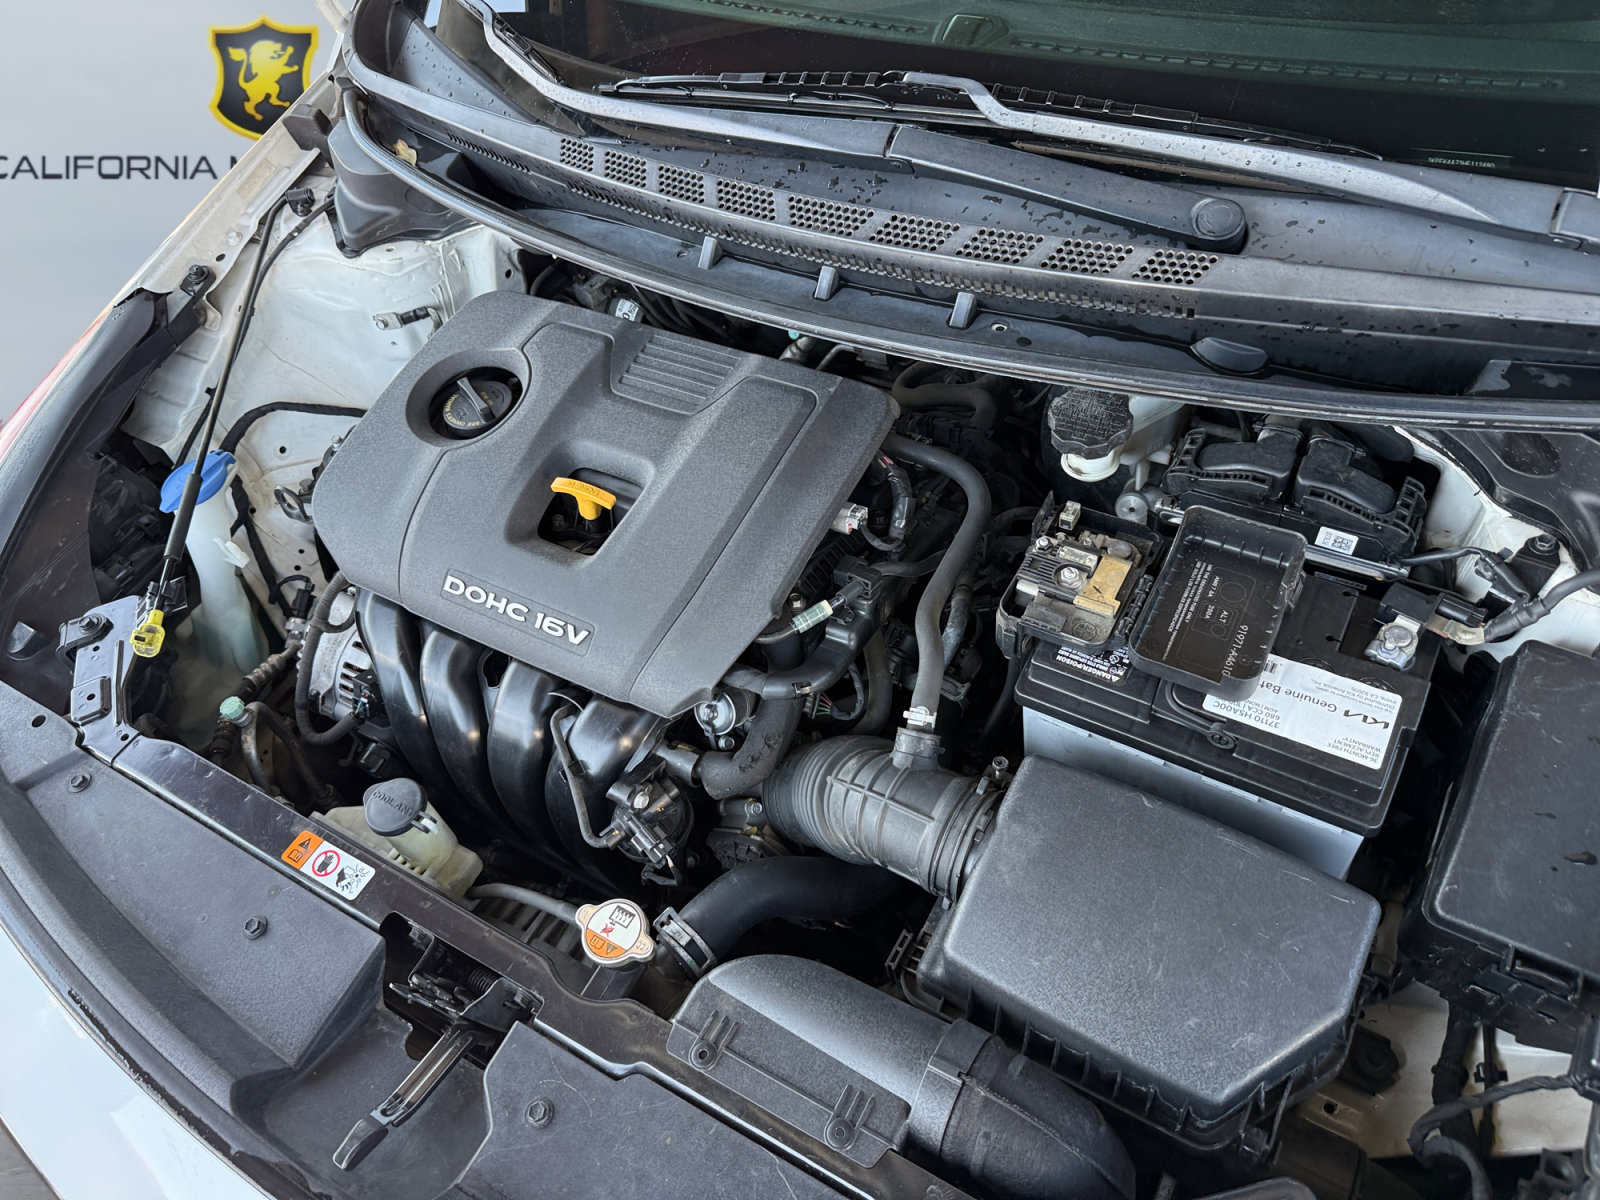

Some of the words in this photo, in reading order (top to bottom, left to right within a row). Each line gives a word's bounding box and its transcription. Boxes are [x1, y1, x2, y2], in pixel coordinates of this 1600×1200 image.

[443, 575, 530, 622] DOHC
[534, 612, 590, 646] 16V
[1183, 611, 1192, 623] ONLY
[1203, 604, 1214, 619] 200A
[1218, 609, 1229, 622] ALT
[1056, 655, 1112, 679] DANGER/POISON
[1257, 679, 1281, 694] Bat
[1285, 689, 1337, 713] Genuine
[1364, 696, 1394, 710] Distributed
[1212, 699, 1252, 719] H5A00C
[1246, 704, 1263, 715] CCA
[1264, 710, 1280, 721] 680
[1253, 714, 1280, 728] 37110
[1343, 709, 1389, 729] KIA
[1326, 741, 1342, 750] FREE
[1333, 738, 1379, 757] REPLACEMENT
[372, 791, 415, 818] COOLANT
